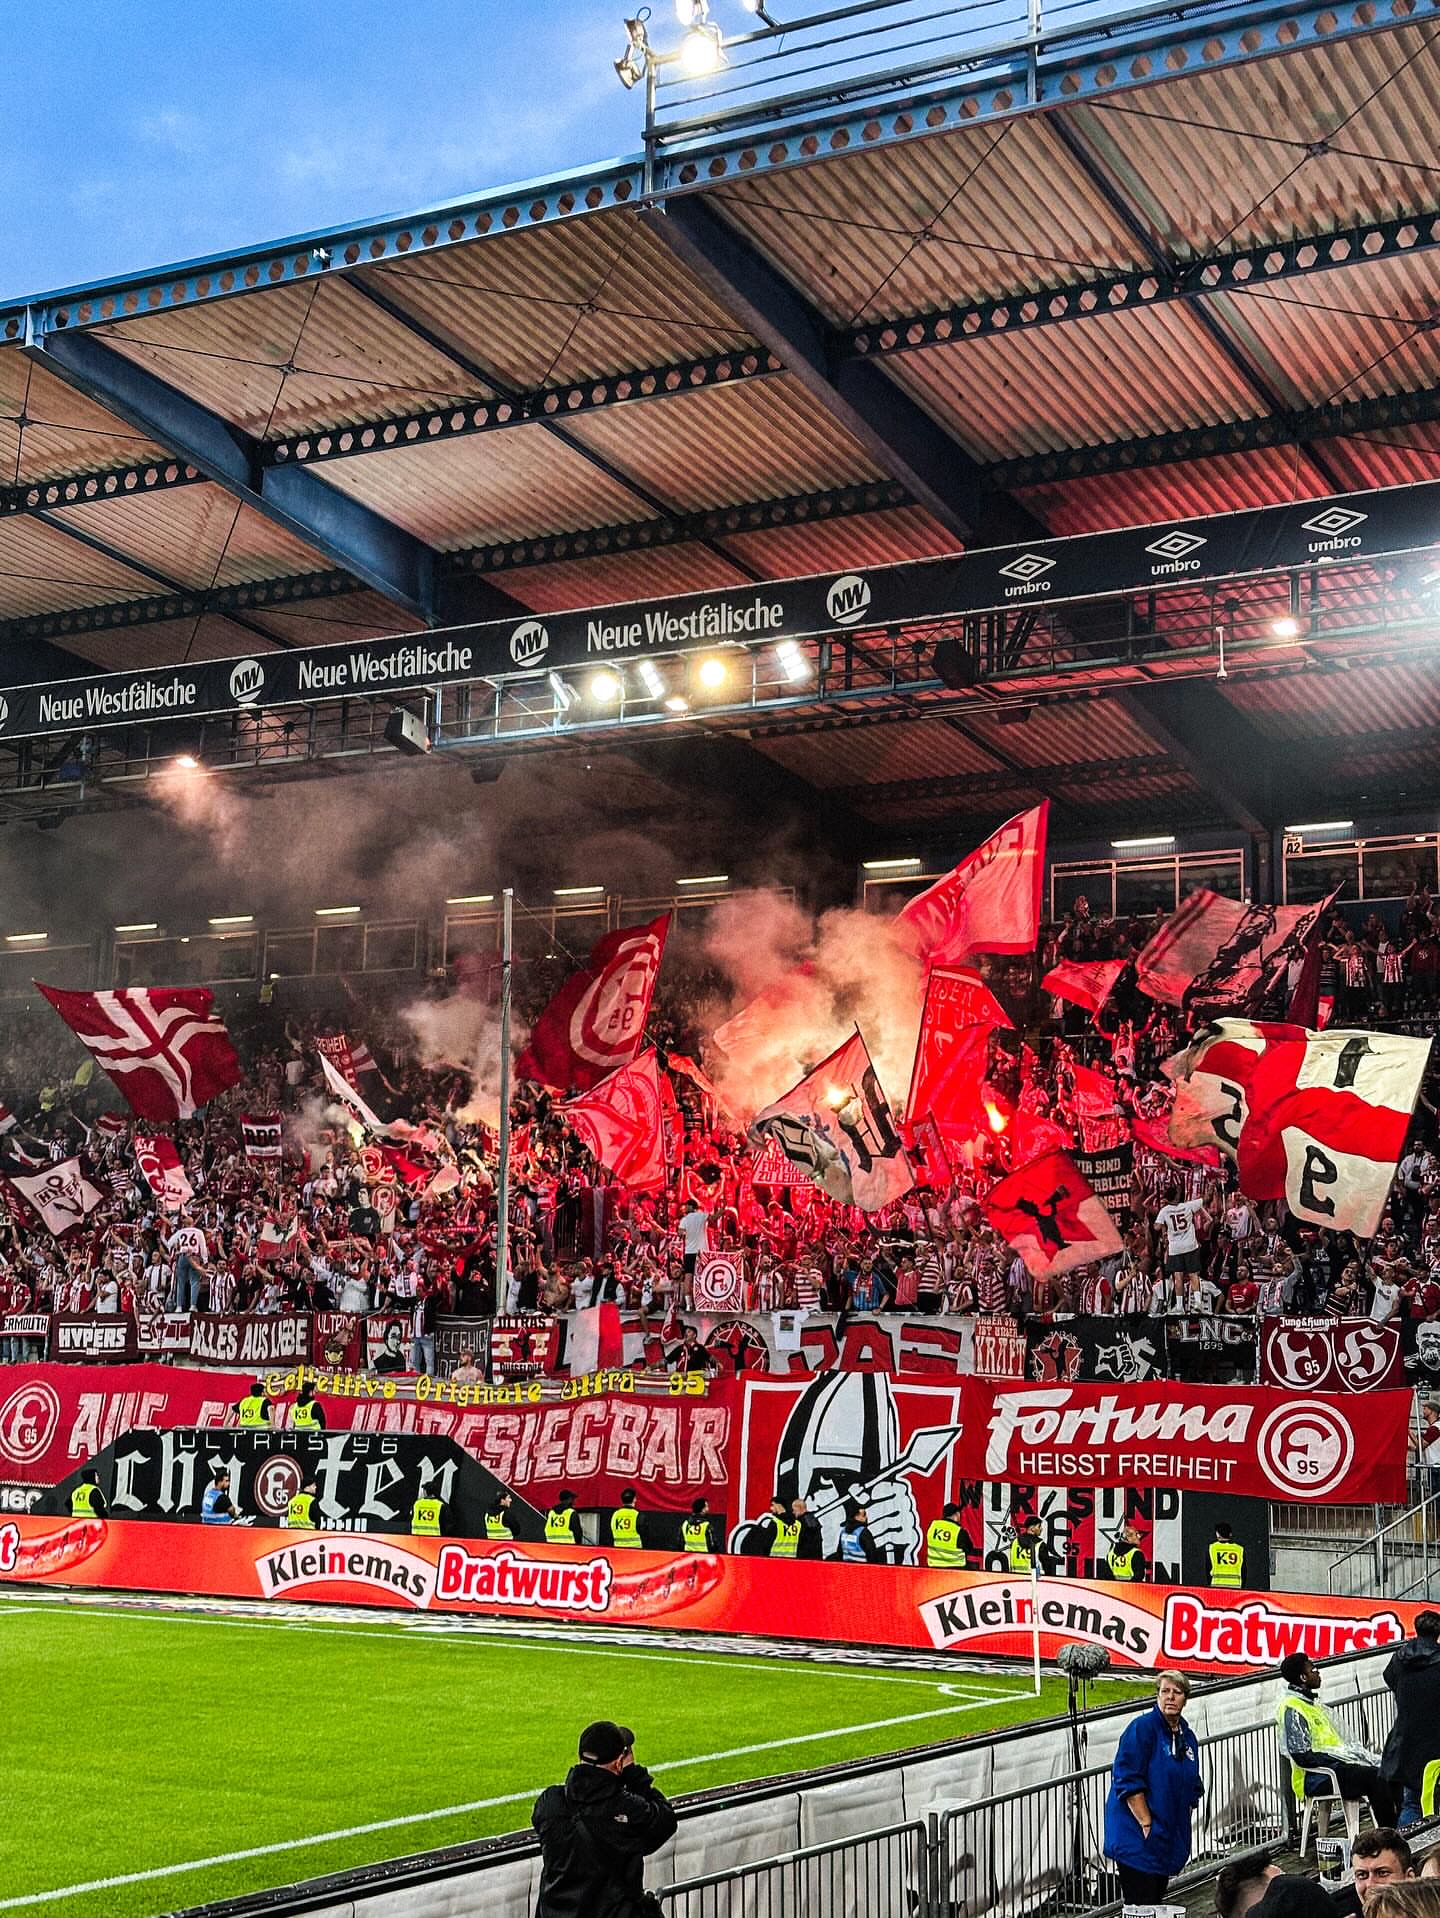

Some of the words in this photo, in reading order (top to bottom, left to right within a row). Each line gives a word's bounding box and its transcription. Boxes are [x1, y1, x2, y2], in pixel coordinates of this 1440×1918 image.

[1308, 534, 1361, 553] umbro
[1151, 558, 1201, 576] umbro
[831, 581, 865, 614] NW
[1004, 580, 1051, 598] umbro
[586, 620, 642, 652] Neue
[644, 598, 783, 644] Westfälische
[514, 626, 544, 657] NW
[298, 660, 348, 690] Neue
[349, 641, 473, 684] Westfälische
[233, 664, 261, 696] NW
[39, 694, 84, 723] Neue
[86, 677, 196, 717] Westfälische
[1169, 1213, 1188, 1231] 15
[180, 1233, 197, 1247] 26
[58, 1327, 127, 1349] HYPERS
[191, 1319, 238, 1360] ALLES
[240, 1322, 269, 1361] AUS
[975, 1336, 1027, 1375] KRAFT
[1304, 1360, 1320, 1377] 95
[415, 1375, 542, 1407] Originale
[668, 1370, 706, 1396] 95
[241, 1408, 255, 1419] K9
[294, 1408, 308, 1419] K9
[24, 1428, 38, 1444] 95
[985, 1388, 1254, 1476] Fortuna
[179, 1432, 325, 1452] ULTRAS
[352, 1437, 399, 1454] 96
[1019, 1451, 1106, 1476] HEISST
[1117, 1453, 1238, 1482] FREIHEIT
[1297, 1460, 1320, 1475] 95
[276, 1489, 289, 1505] 95
[1069, 1485, 1180, 1520] SIND
[289, 1503, 304, 1515] K9
[418, 1510, 435, 1521] K9
[550, 1515, 566, 1528] K9
[615, 1518, 632, 1531] K9
[685, 1524, 702, 1536] K9
[783, 1524, 799, 1537] K9
[932, 1529, 952, 1542] K9
[1062, 1542, 1080, 1555] 95
[1112, 1555, 1127, 1568] K9
[1217, 1551, 1239, 1566] K9
[267, 1545, 427, 1598] Kleinemas
[441, 1552, 607, 1604] Bratwurst
[935, 1589, 1150, 1654] Kleinemas
[1171, 1602, 1395, 1659] Bratwurst
